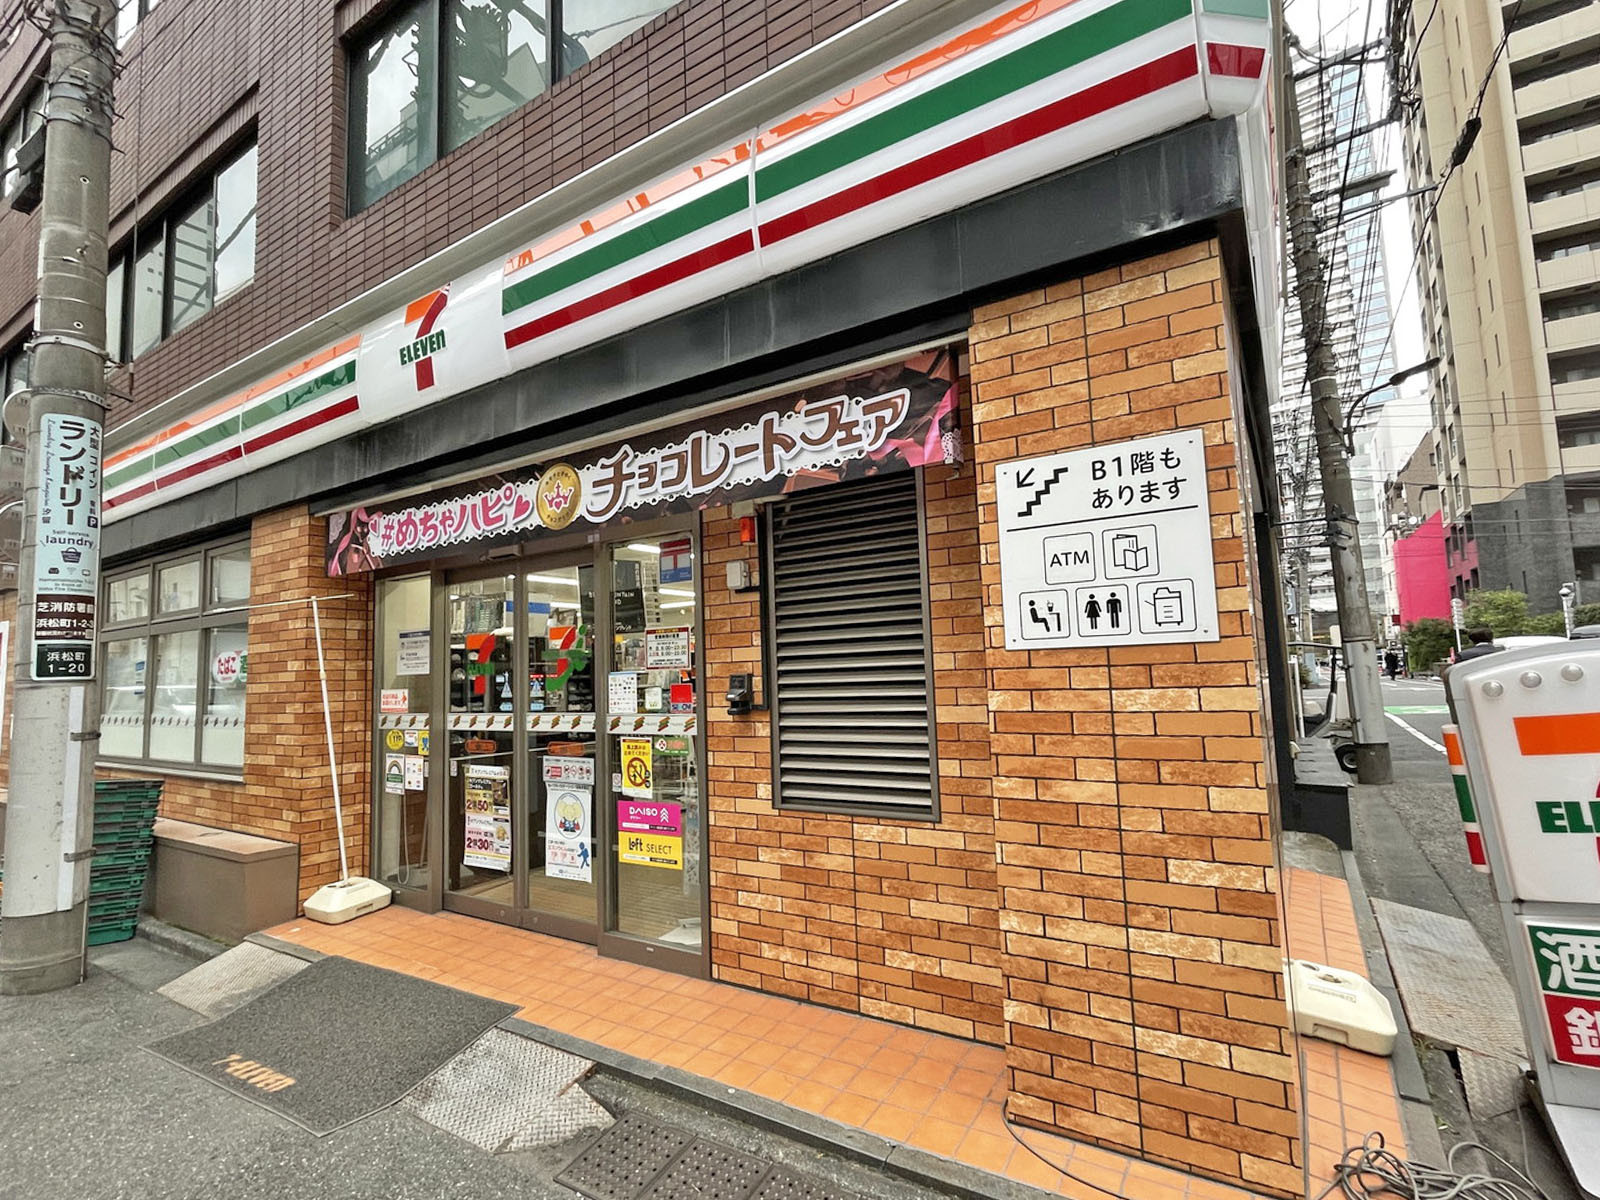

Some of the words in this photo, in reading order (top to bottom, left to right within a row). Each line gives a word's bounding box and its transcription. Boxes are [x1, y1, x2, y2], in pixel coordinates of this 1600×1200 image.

[586, 393, 906, 517] チョコレートフェア
[59, 420, 86, 525] ランドリー
[1092, 448, 1181, 481] B1階も
[1092, 477, 1187, 510] あります
[46, 535, 93, 549] laundry
[1050, 550, 1089, 568] ATM
[47, 651, 85, 662] 浜松町
[48, 663, 85, 673] 1-20
[629, 806, 658, 816] DAISO
[646, 843, 672, 855] SELECT
